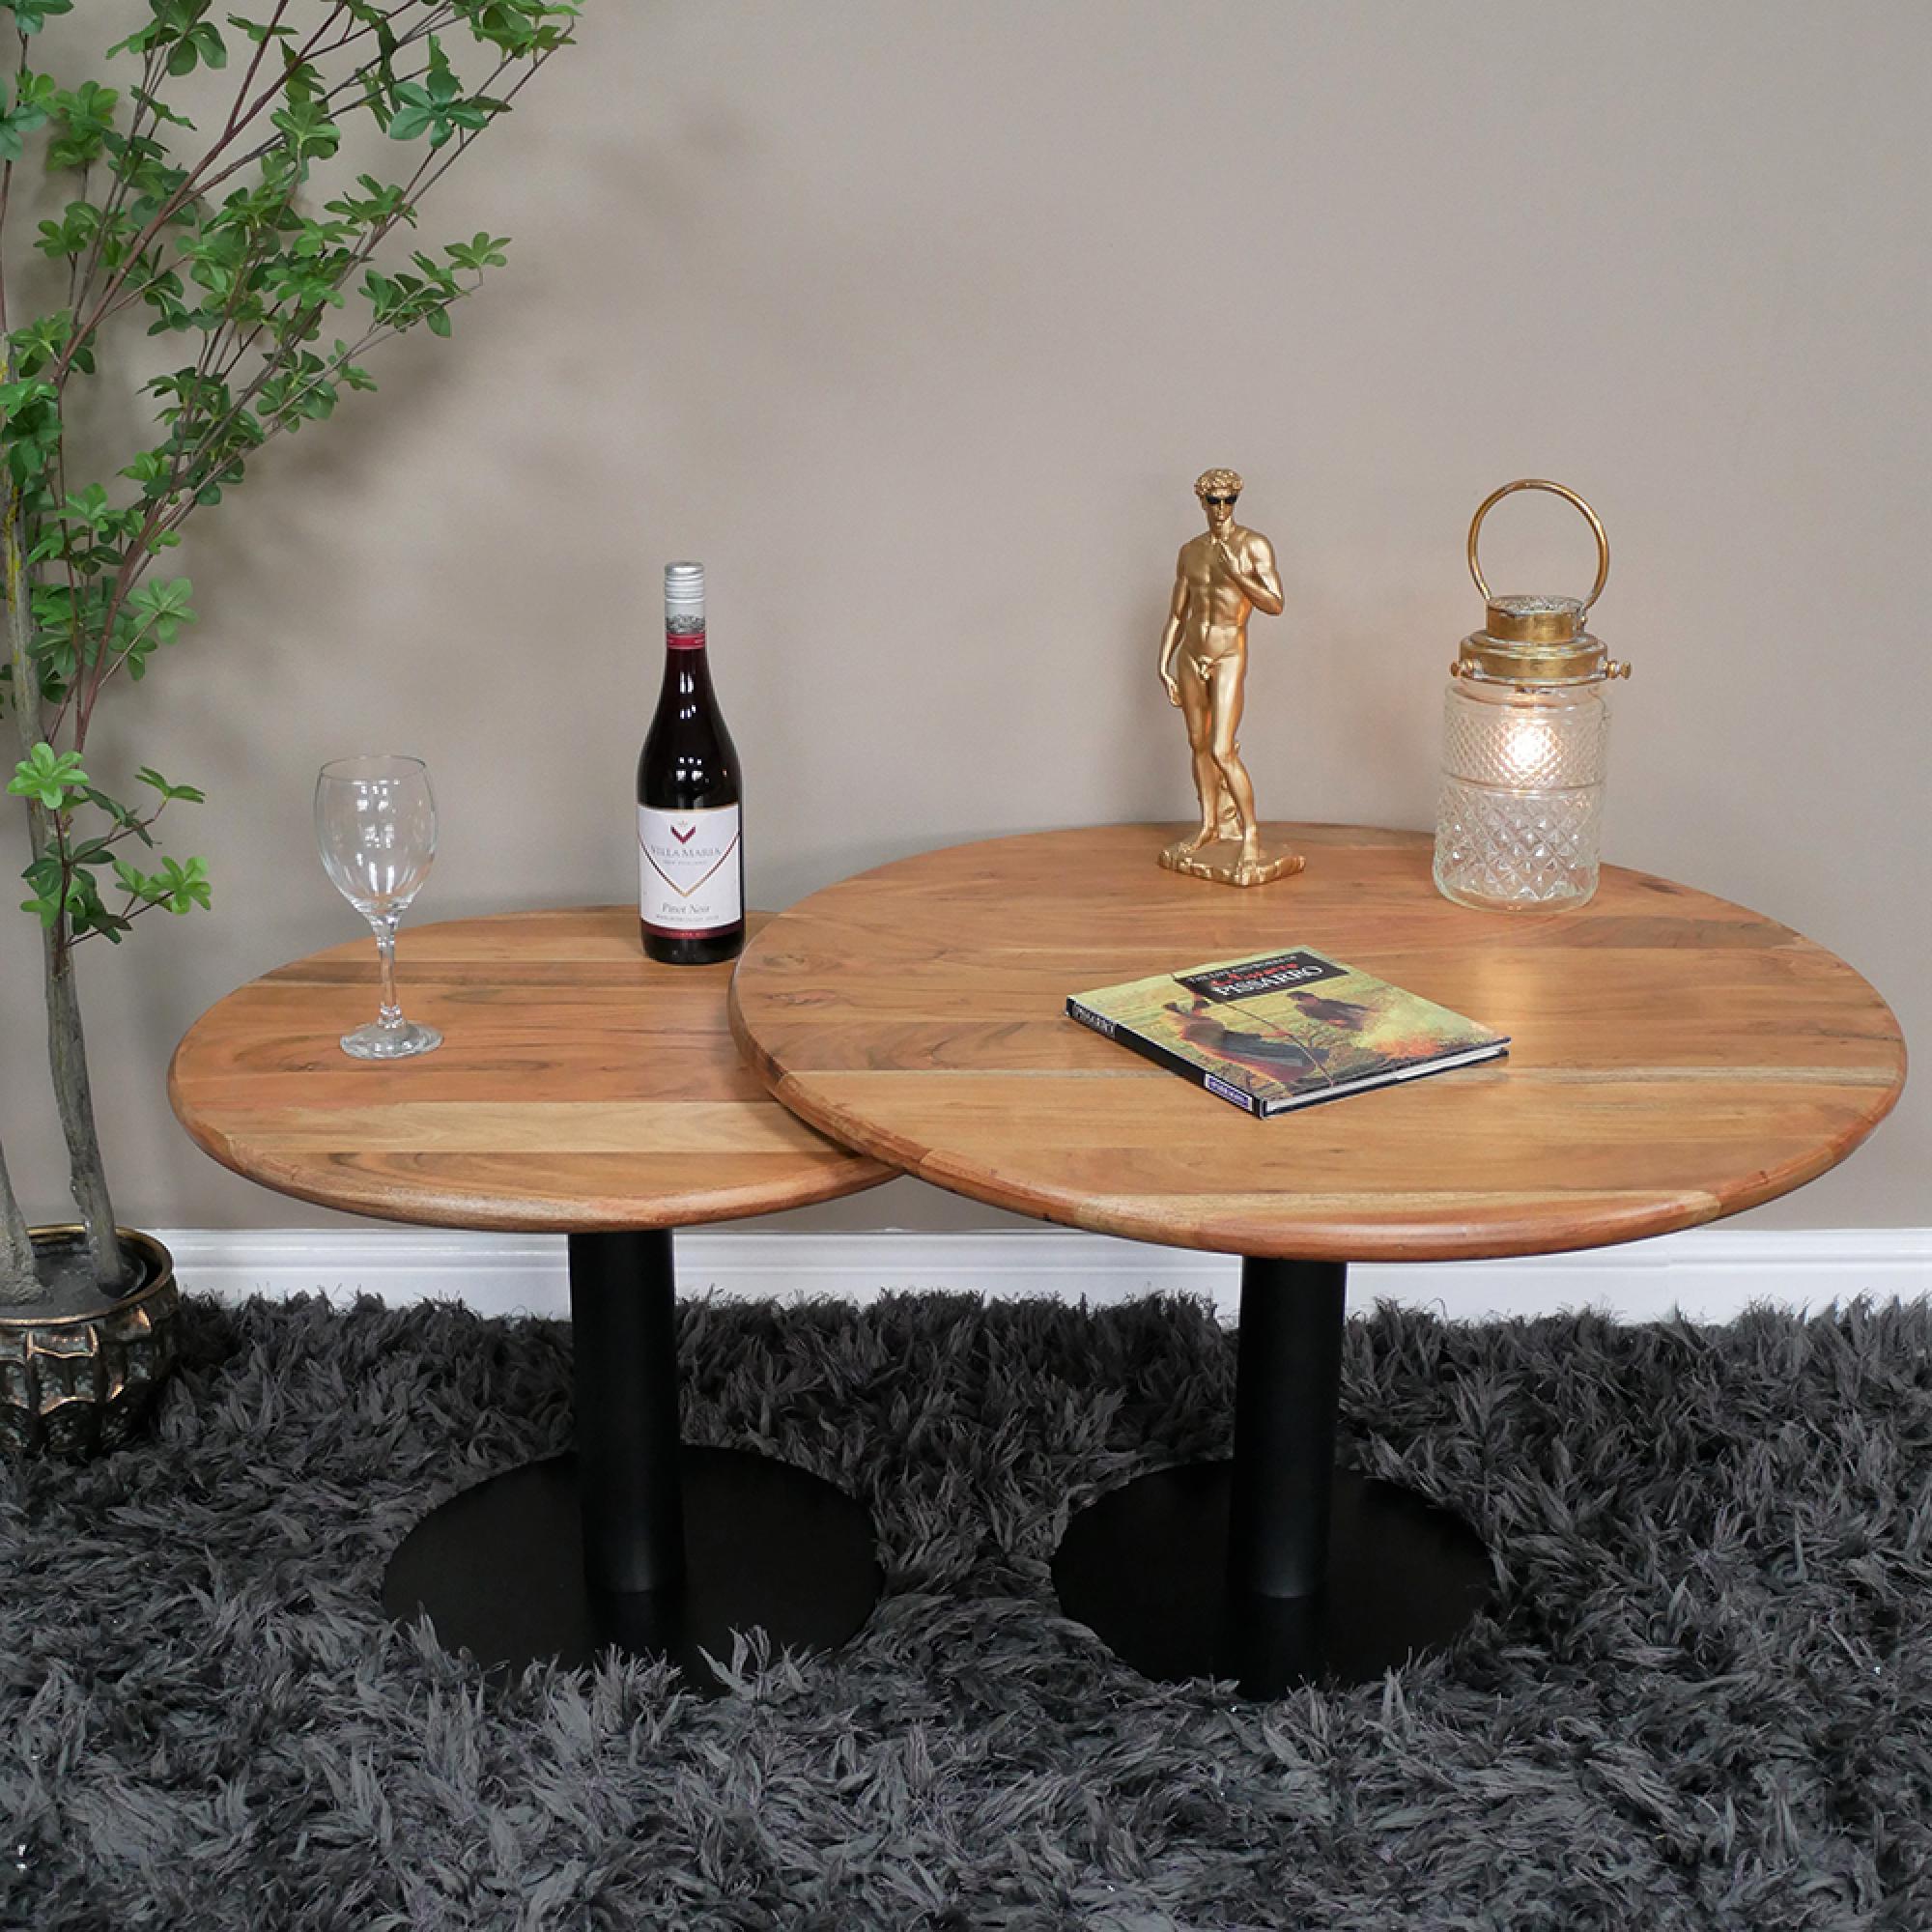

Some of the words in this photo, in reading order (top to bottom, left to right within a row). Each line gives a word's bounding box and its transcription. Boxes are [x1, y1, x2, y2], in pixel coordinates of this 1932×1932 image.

[682, 847, 721, 858] MARIA
[662, 902, 686, 914] Pinot
[690, 903, 710, 914] Noir
[1211, 966, 1323, 996] PISSARRO
